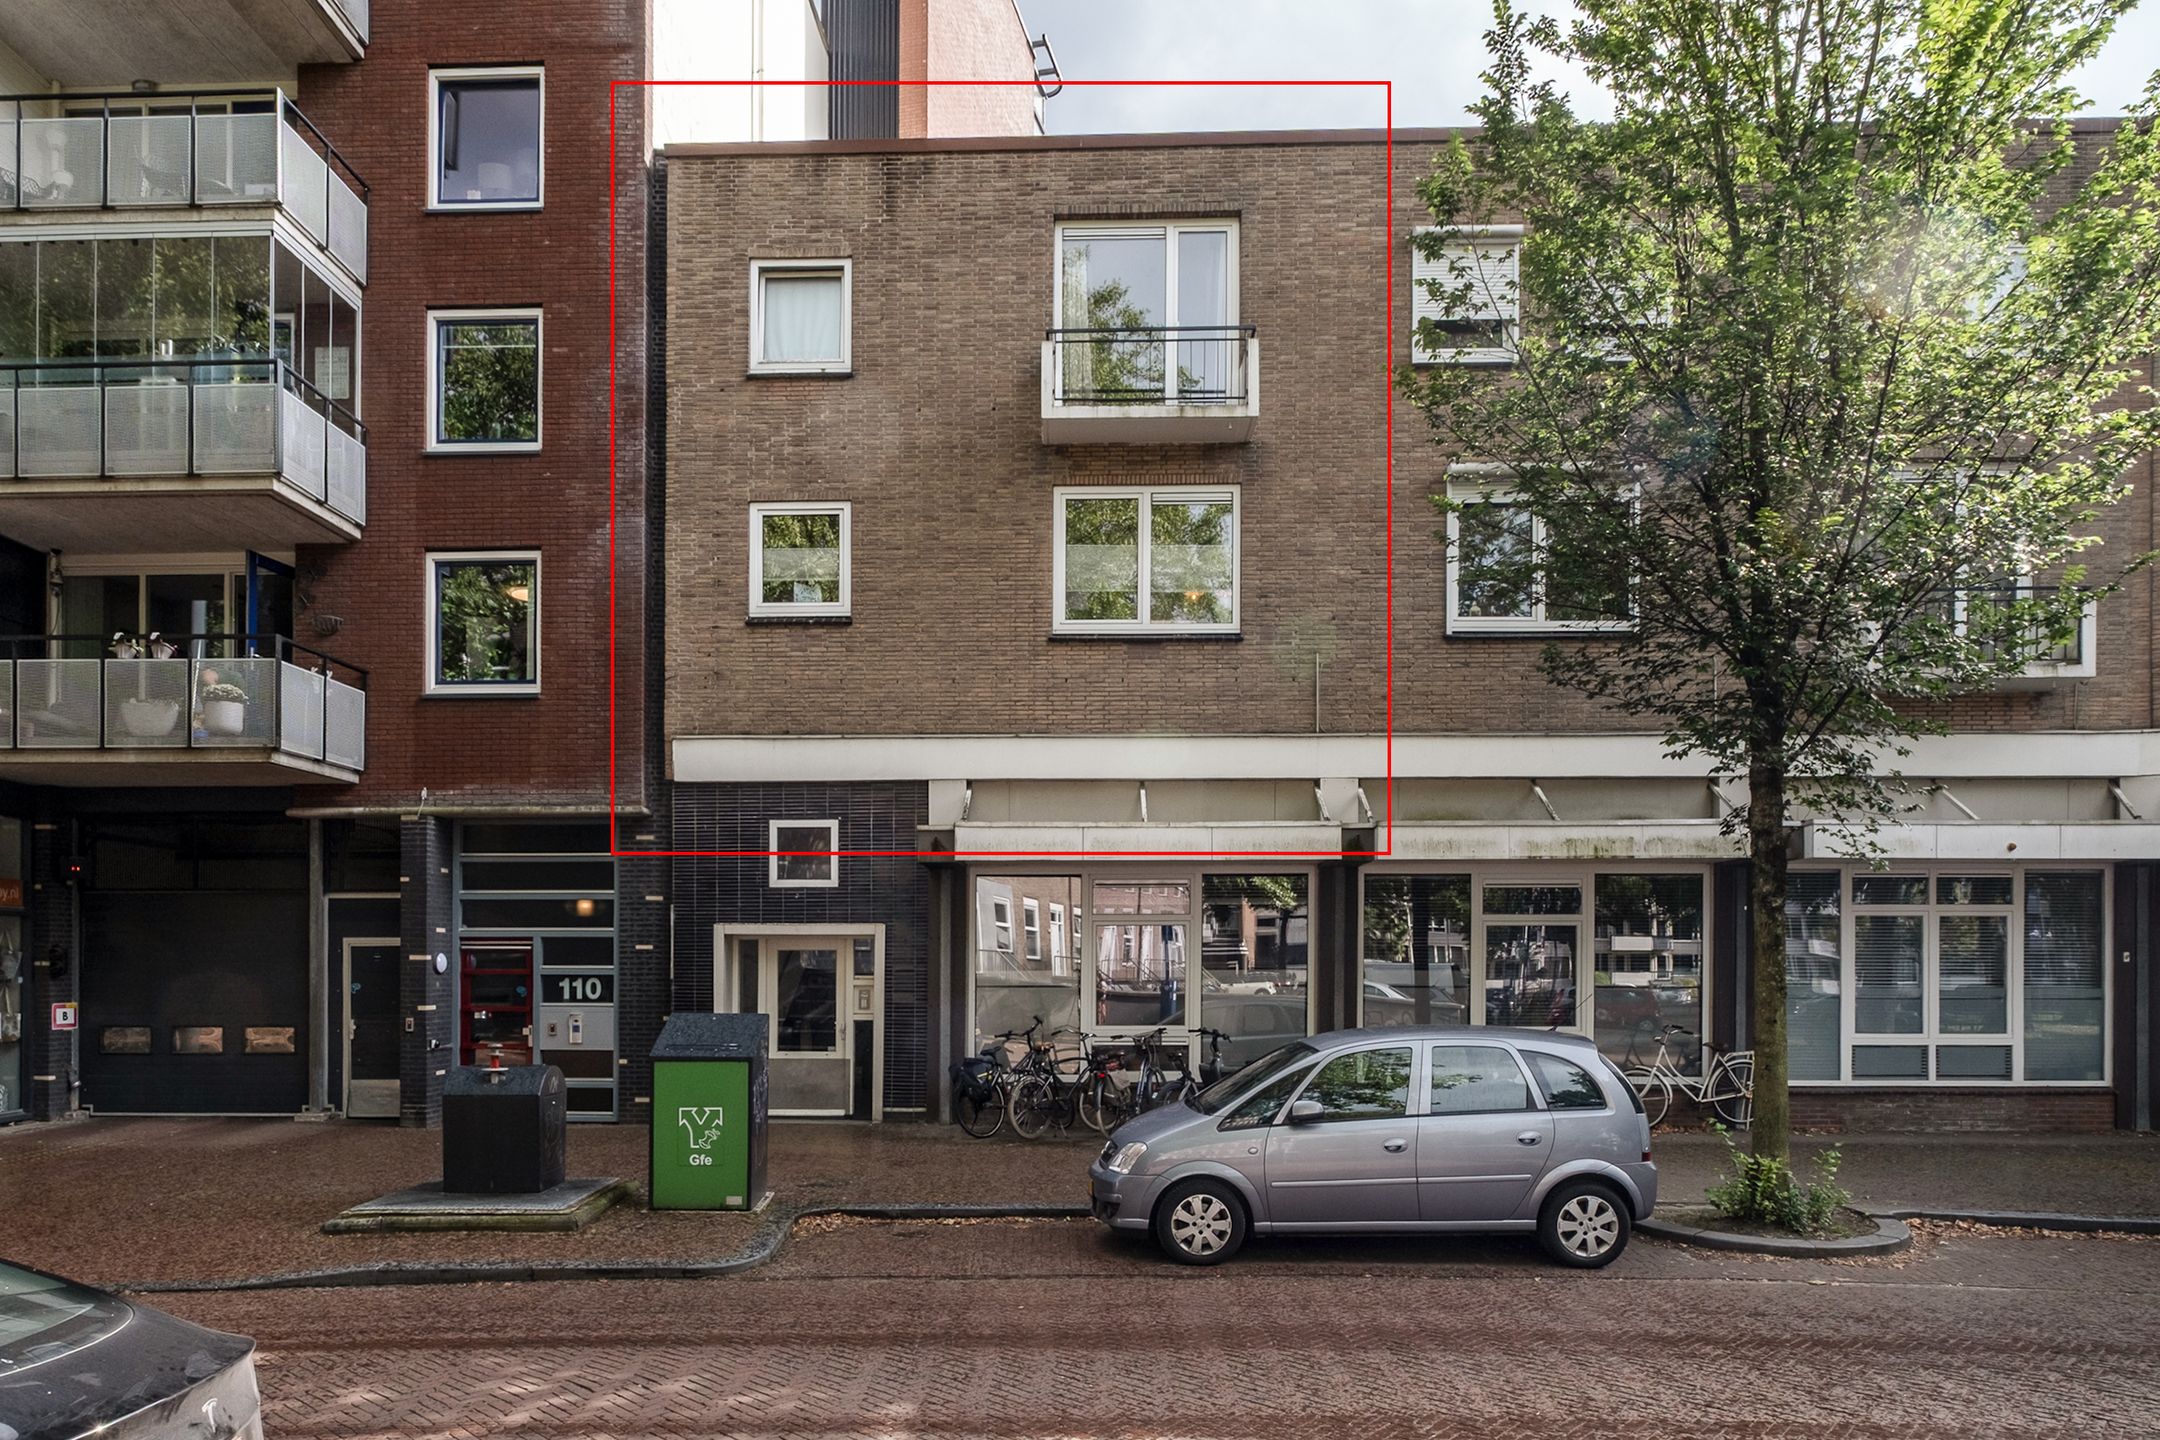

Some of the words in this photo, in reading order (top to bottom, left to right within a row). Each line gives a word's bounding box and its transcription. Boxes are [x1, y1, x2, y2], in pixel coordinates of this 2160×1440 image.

[559, 977, 602, 1000] 110
[62, 1011, 69, 1021] B
[689, 1154, 713, 1166] Gfe
